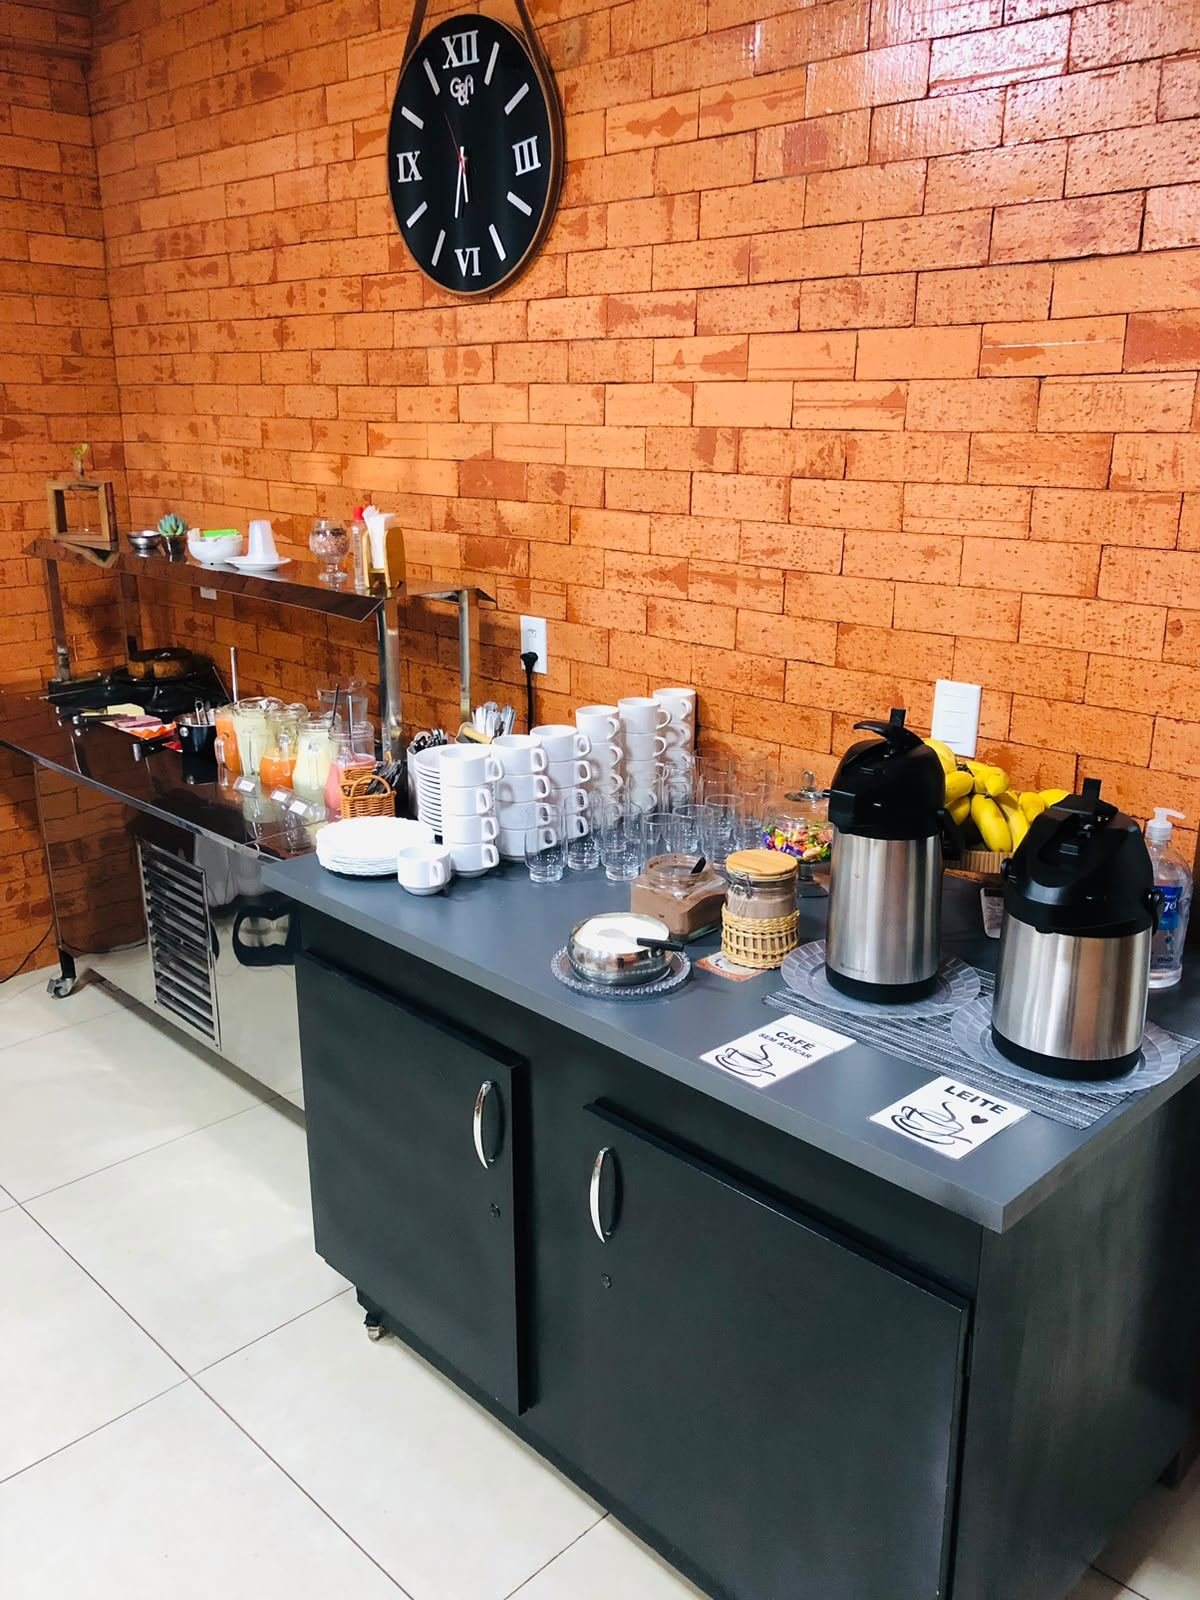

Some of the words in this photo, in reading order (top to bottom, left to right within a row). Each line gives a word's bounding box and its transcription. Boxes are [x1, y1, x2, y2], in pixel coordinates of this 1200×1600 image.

[442, 30, 480, 69] XII
[396, 151, 422, 183] IX
[512, 136, 541, 176] III
[454, 247, 481, 277] VI
[758, 1033, 778, 1043] SEM
[944, 1085, 1009, 1115] LEITE
